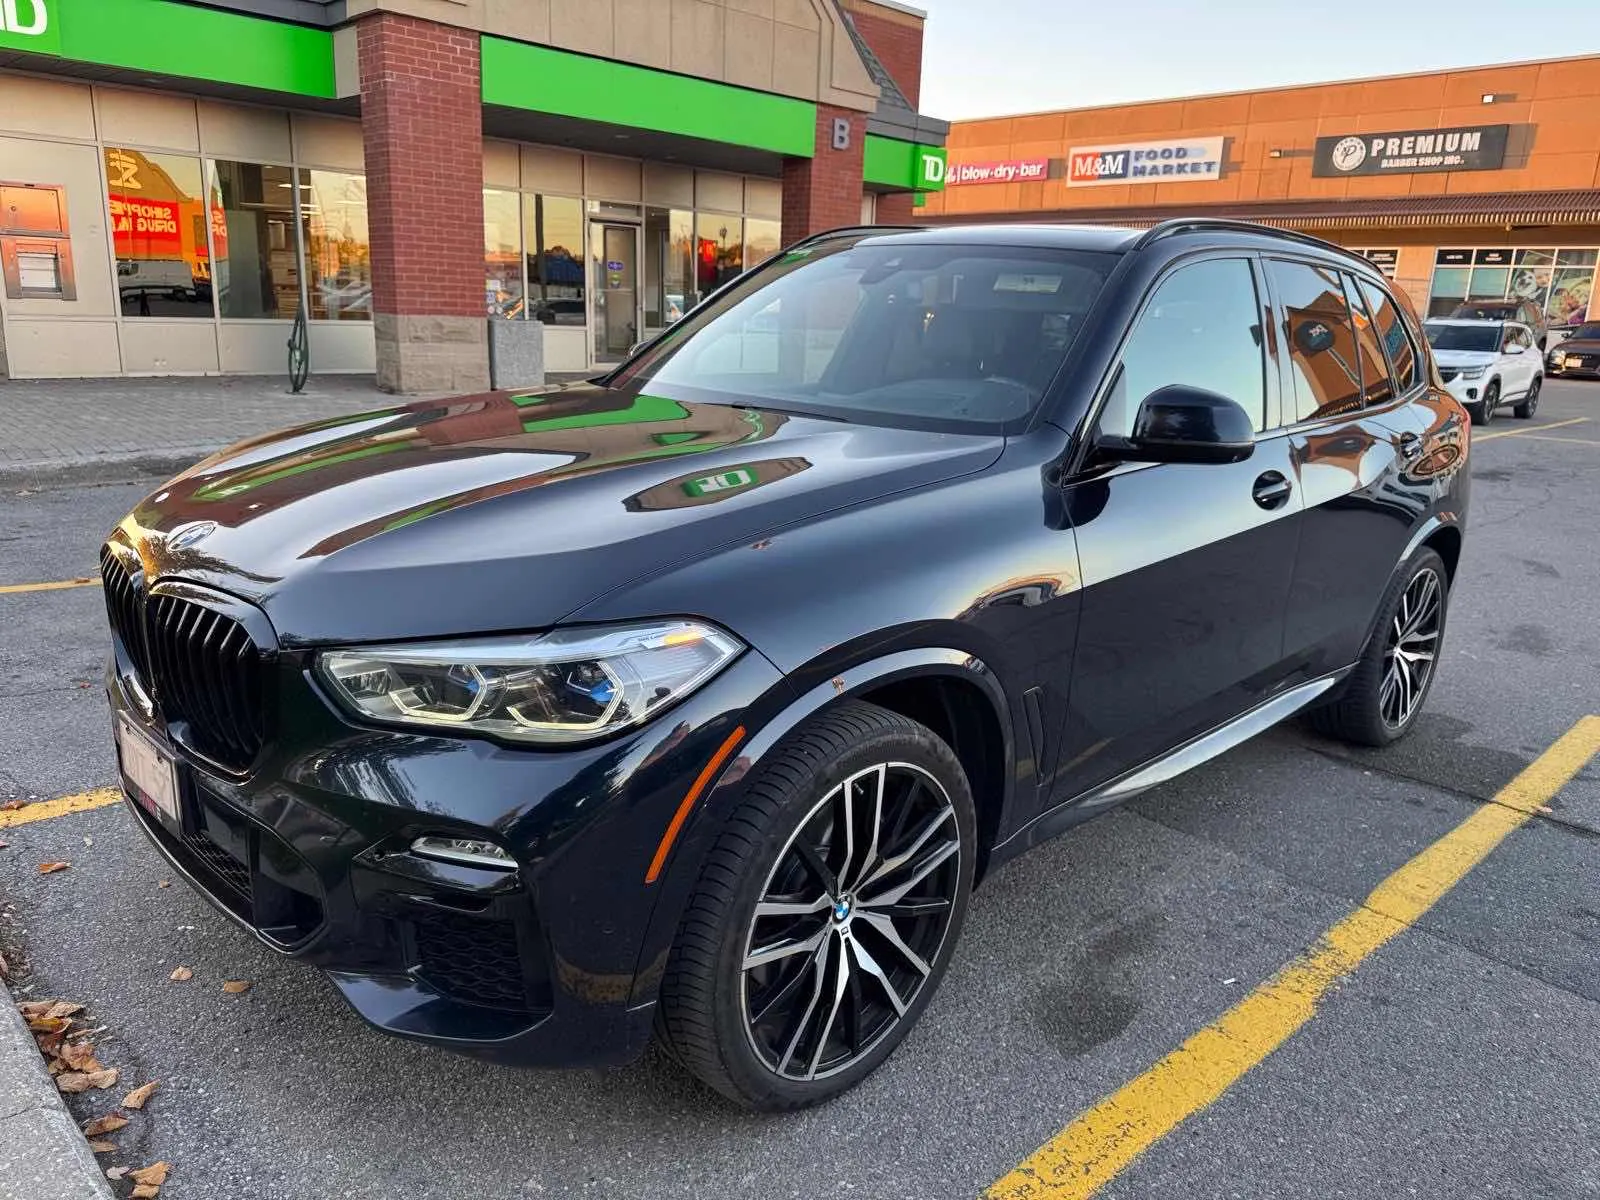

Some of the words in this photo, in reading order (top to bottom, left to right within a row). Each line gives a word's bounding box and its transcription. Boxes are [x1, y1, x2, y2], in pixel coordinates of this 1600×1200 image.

[832, 117, 850, 150] B
[1370, 132, 1481, 157] PREMIUM
[1073, 153, 1125, 177] M&M
[1133, 147, 1188, 162] FOOD
[1418, 156, 1443, 167] SHOP
[922, 154, 944, 182] TD
[1132, 161, 1216, 177] MARKET
